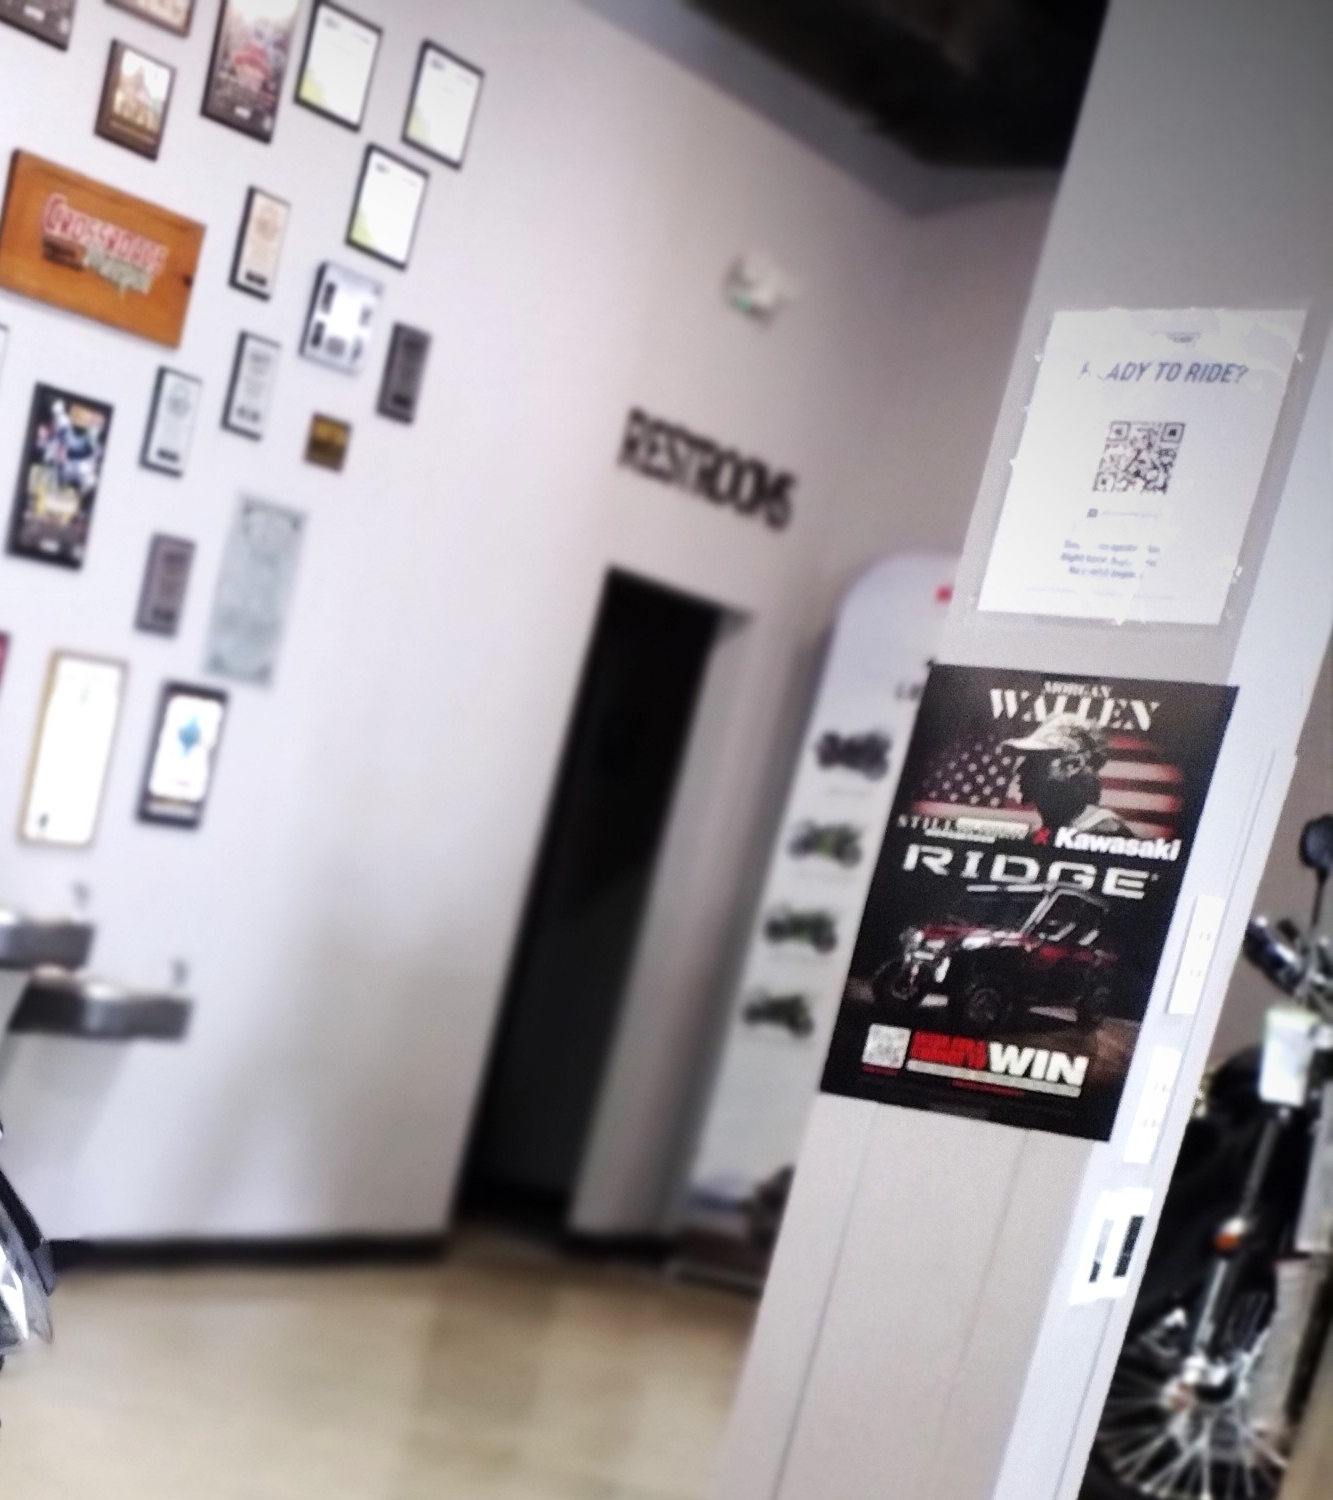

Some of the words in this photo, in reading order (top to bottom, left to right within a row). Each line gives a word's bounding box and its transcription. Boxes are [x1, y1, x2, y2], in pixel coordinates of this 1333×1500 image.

[1077, 360, 1152, 383] ADY
[1154, 361, 1183, 383] TO
[1184, 362, 1249, 385] RIDE?
[1053, 826, 1181, 862] Kawasaki
[901, 843, 1151, 900] RIDGE
[988, 1040, 1090, 1087] WIN
